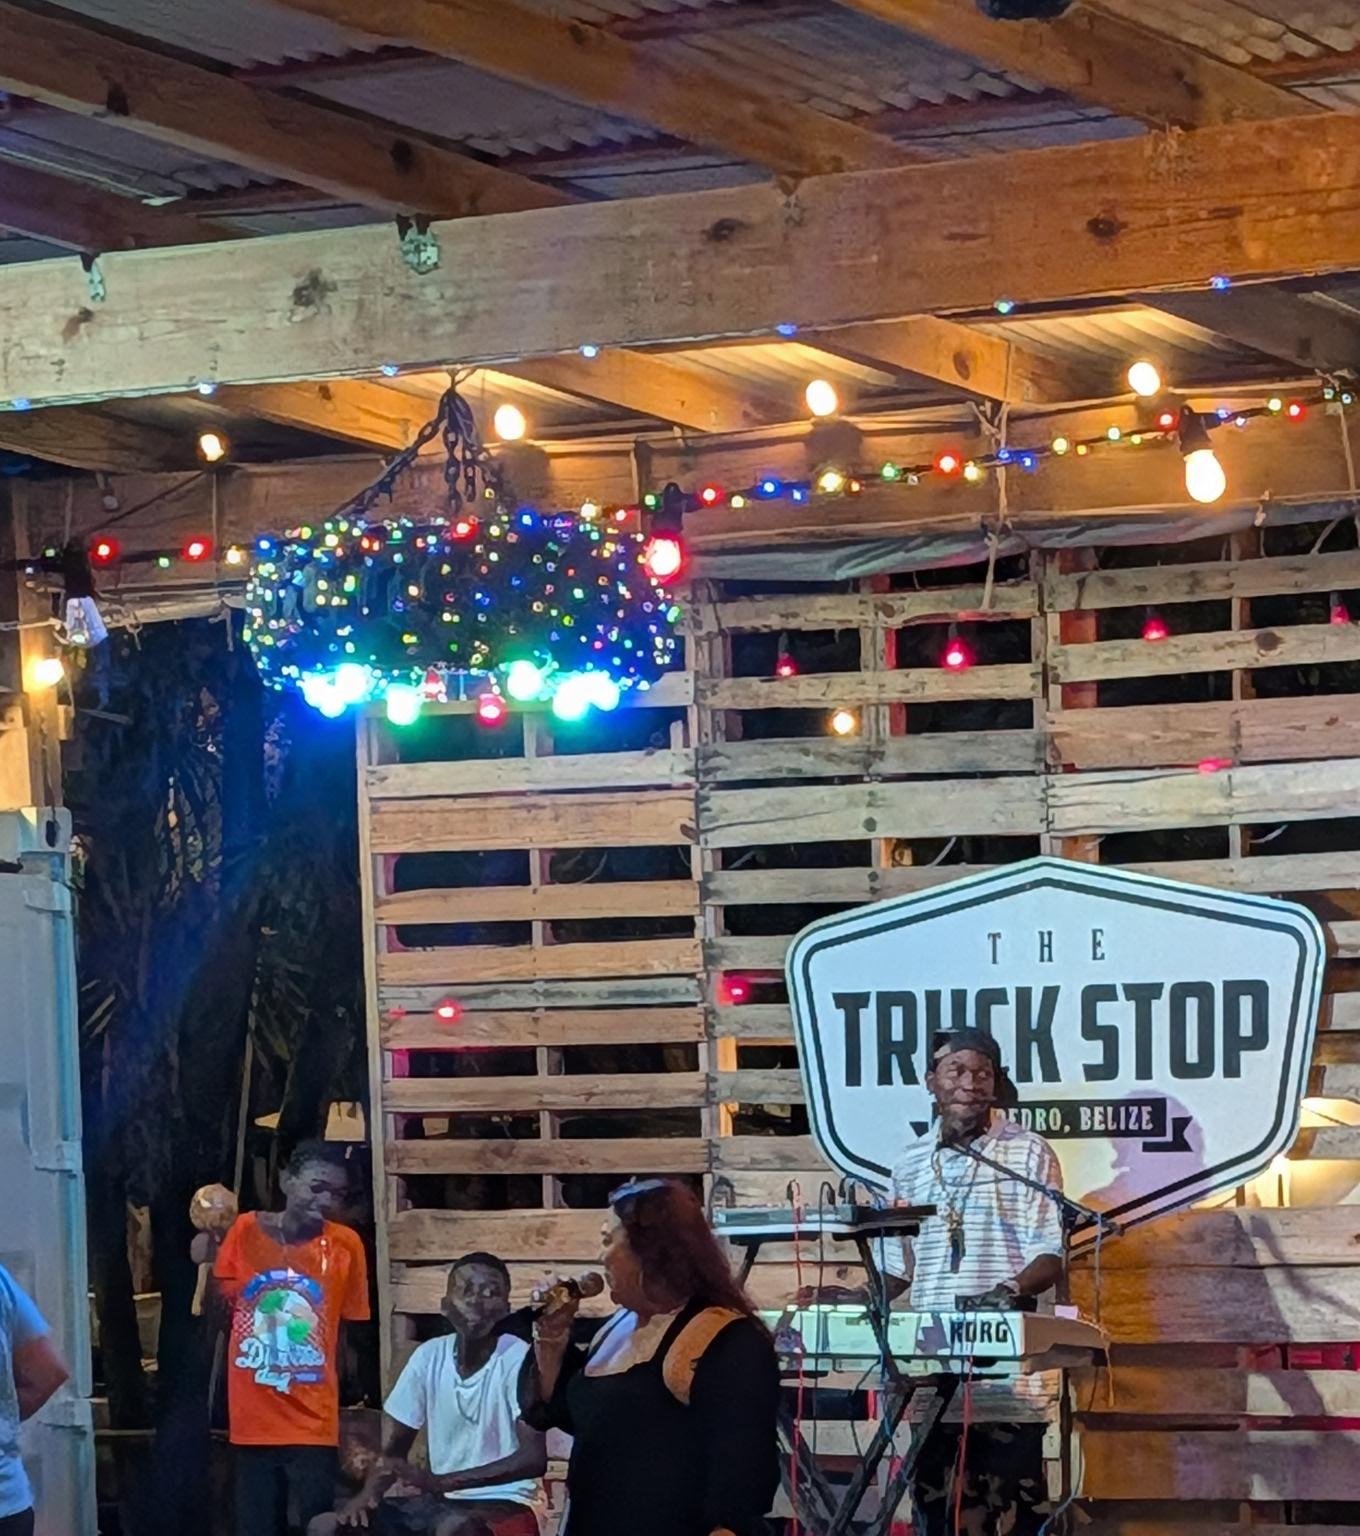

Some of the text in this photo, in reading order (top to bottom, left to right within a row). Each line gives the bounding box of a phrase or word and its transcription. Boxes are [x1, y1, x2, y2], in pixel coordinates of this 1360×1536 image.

[987, 926, 1107, 966] THE
[1080, 979, 1270, 1082] STOP
[1080, 1104, 1155, 1132] BELIZE
[950, 1319, 1008, 1344] KORG
